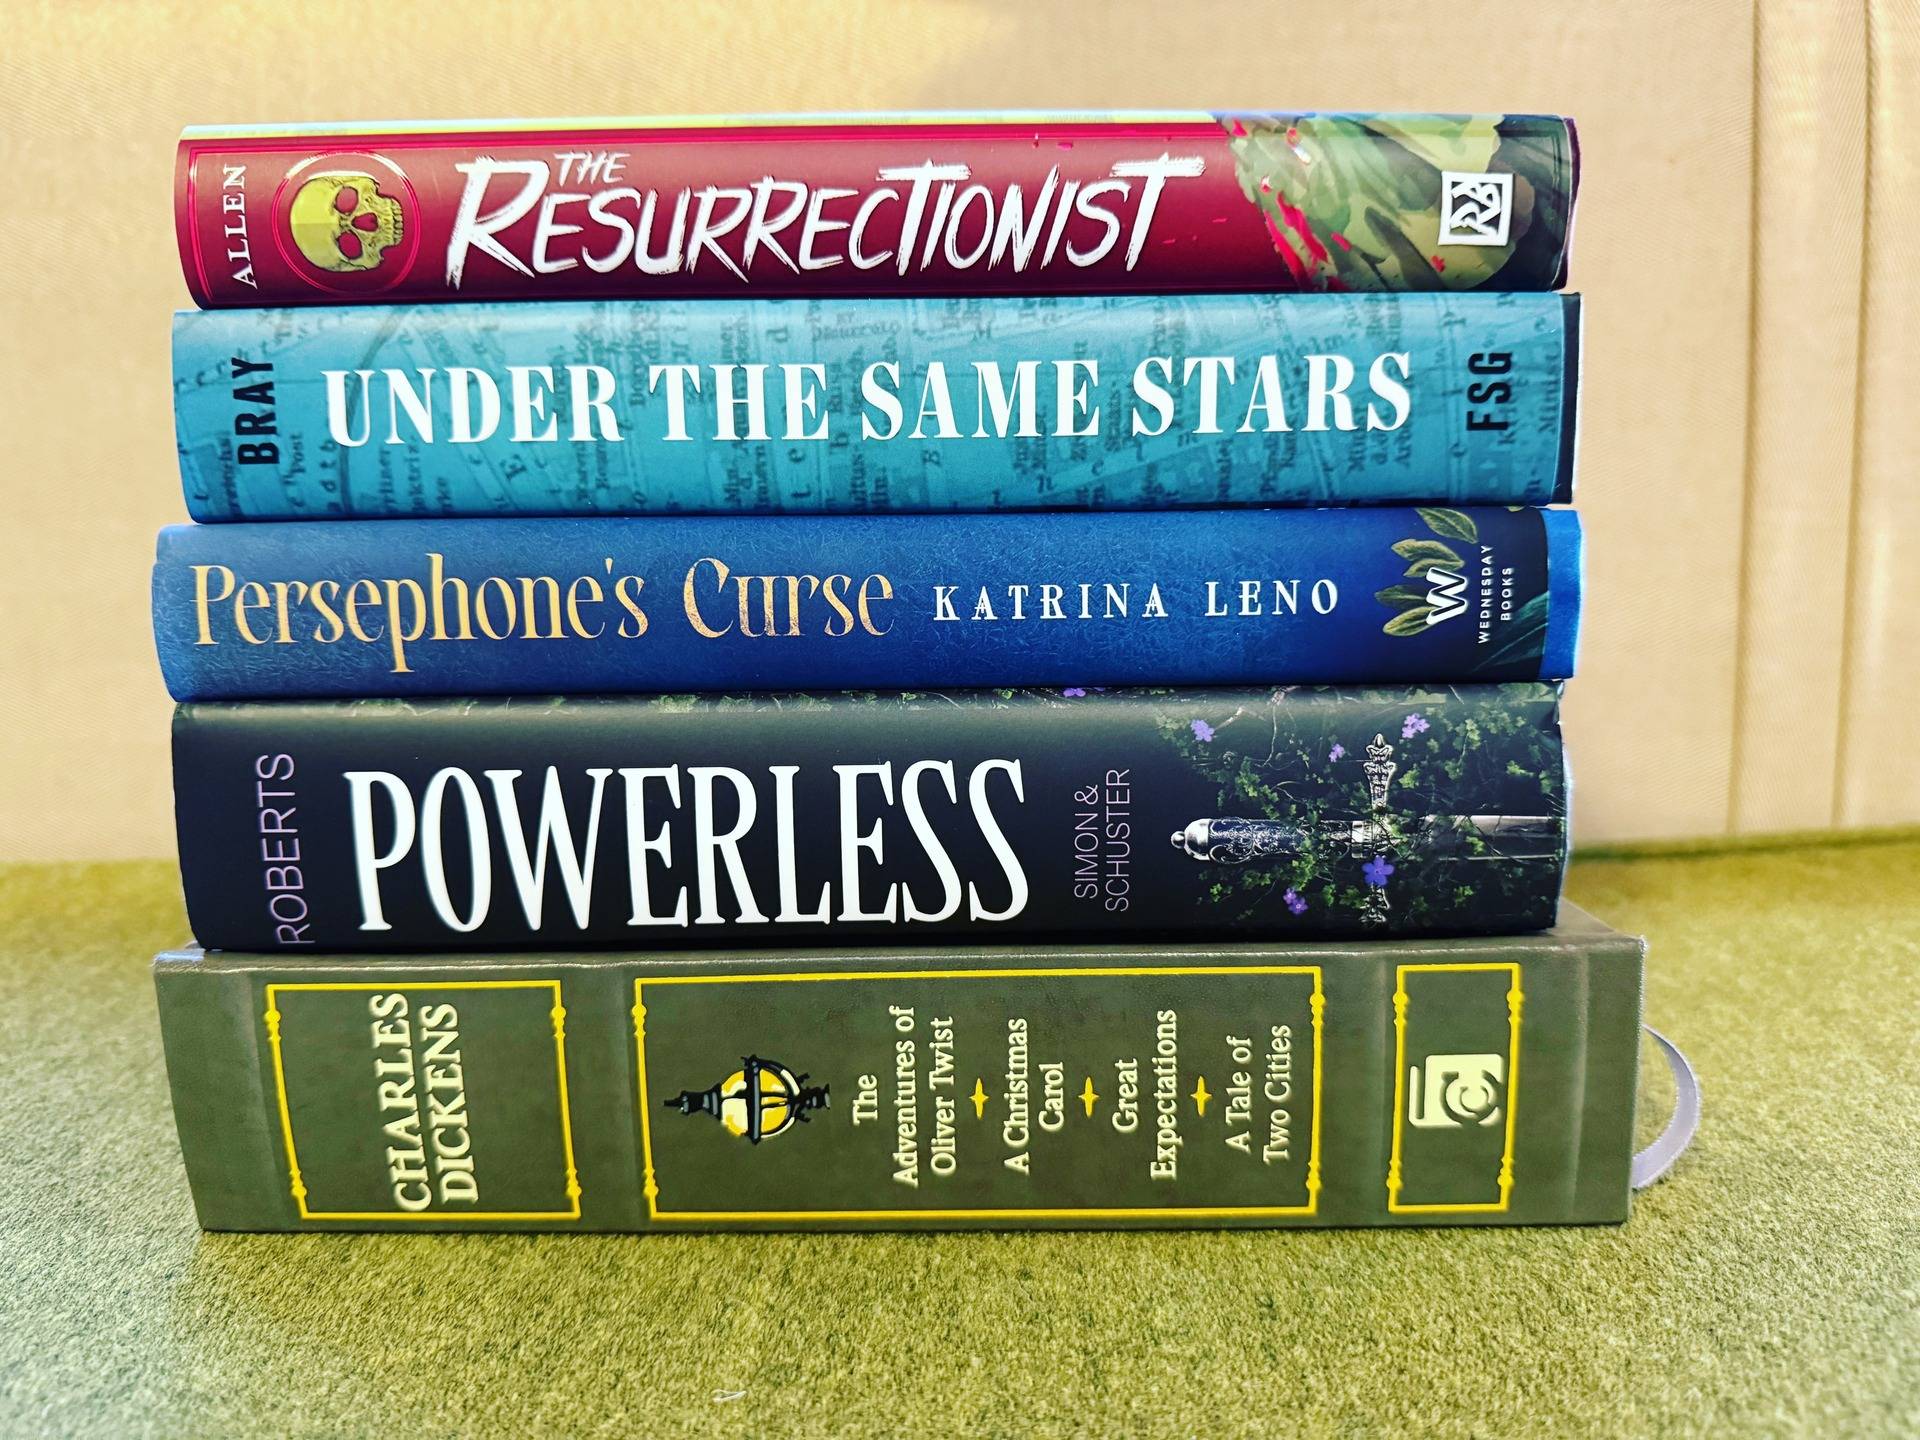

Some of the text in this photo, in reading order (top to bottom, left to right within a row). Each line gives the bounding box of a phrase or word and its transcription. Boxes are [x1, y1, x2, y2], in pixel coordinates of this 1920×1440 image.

[222, 163, 259, 289] ALLEN
[446, 153, 1207, 289] RESURRECTIONIST
[553, 151, 631, 185] THE
[231, 357, 279, 465] BRAY
[321, 365, 625, 447] UNDER
[650, 364, 828, 440] THE
[861, 359, 1100, 441] SAME
[1132, 351, 1410, 437] STARS
[1466, 352, 1513, 431] FSG
[188, 552, 894, 673] Persephone's Curse
[932, 579, 1338, 621] KATRINA LENO
[1477, 545, 1494, 644] WEDNESDAY
[1500, 567, 1514, 621] BOOKS
[255, 753, 316, 945] ROBERTS
[342, 758, 1030, 933] POWERLESS
[1073, 784, 1099, 900] SIMON &
[1104, 768, 1131, 912] SCHUSTER
[369, 992, 432, 1213] CHARLES
[419, 1003, 481, 1204] DICKENS
[852, 1074, 878, 1125] The
[888, 1005, 919, 1187] Adventures of
[928, 1016, 957, 1176] Oliver Twist
[1002, 1018, 1030, 1174] A Christmas
[1038, 1061, 1065, 1132] Carol
[1111, 1058, 1138, 1133] Great
[1150, 1009, 1183, 1178] Expectations
[1225, 1035, 1252, 1153] A Tale of
[1262, 1024, 1292, 1164] Two Cities
